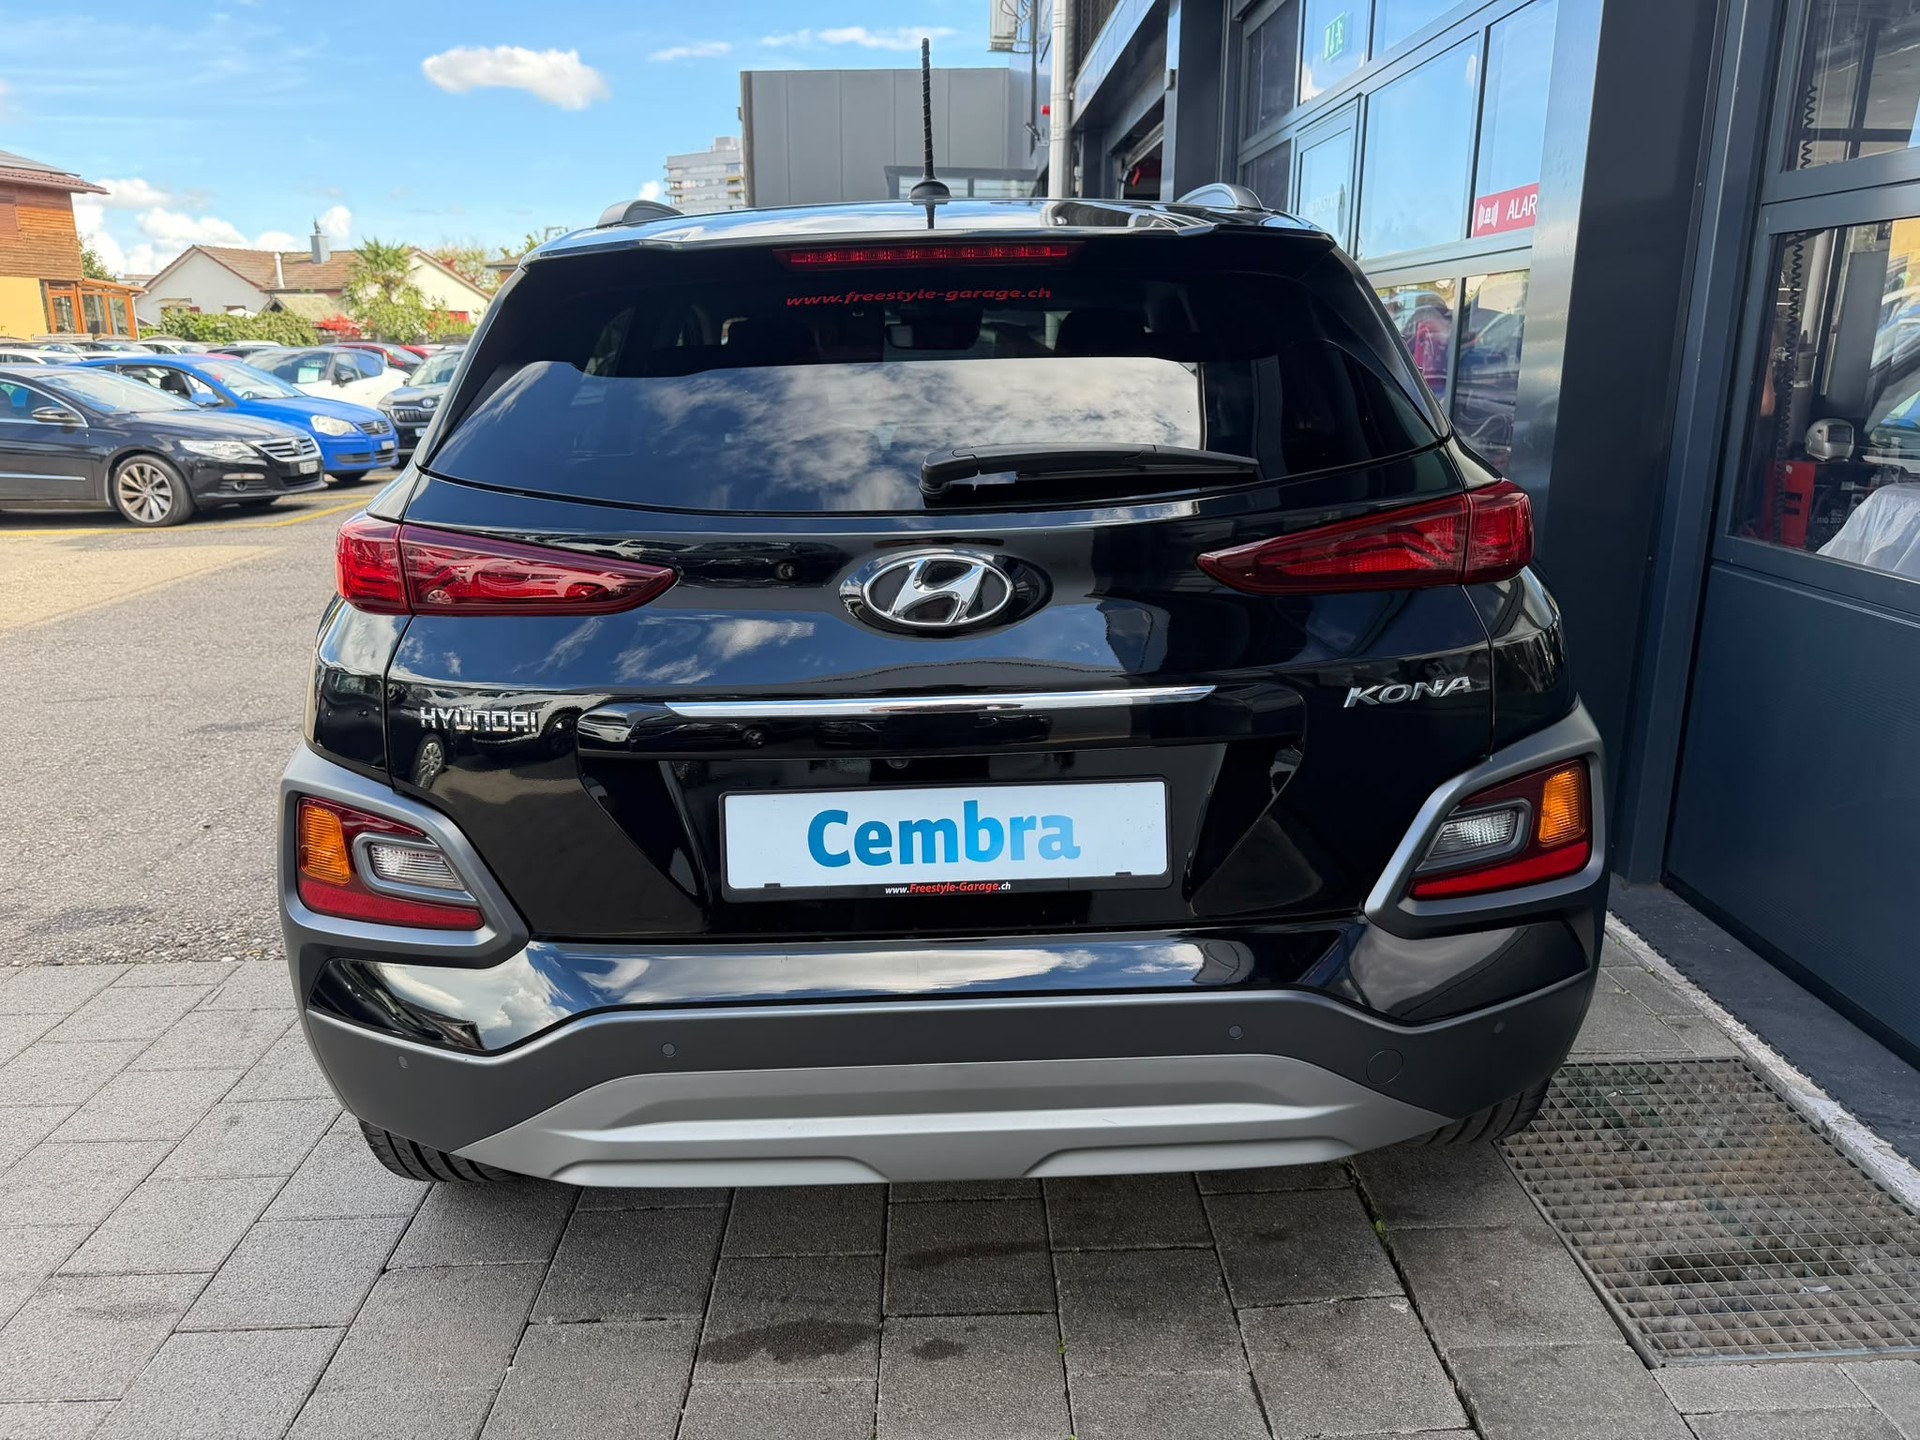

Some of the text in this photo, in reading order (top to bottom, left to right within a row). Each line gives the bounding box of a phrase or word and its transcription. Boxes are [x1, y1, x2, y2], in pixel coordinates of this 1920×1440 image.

[786, 287, 1051, 306] www.freestyle-garage.ch
[1343, 676, 1472, 708] KONA
[420, 706, 537, 732] HYUNDAI
[807, 800, 1081, 868] Cembra
[885, 881, 1011, 895] www.Freestyle-Garage.ch
